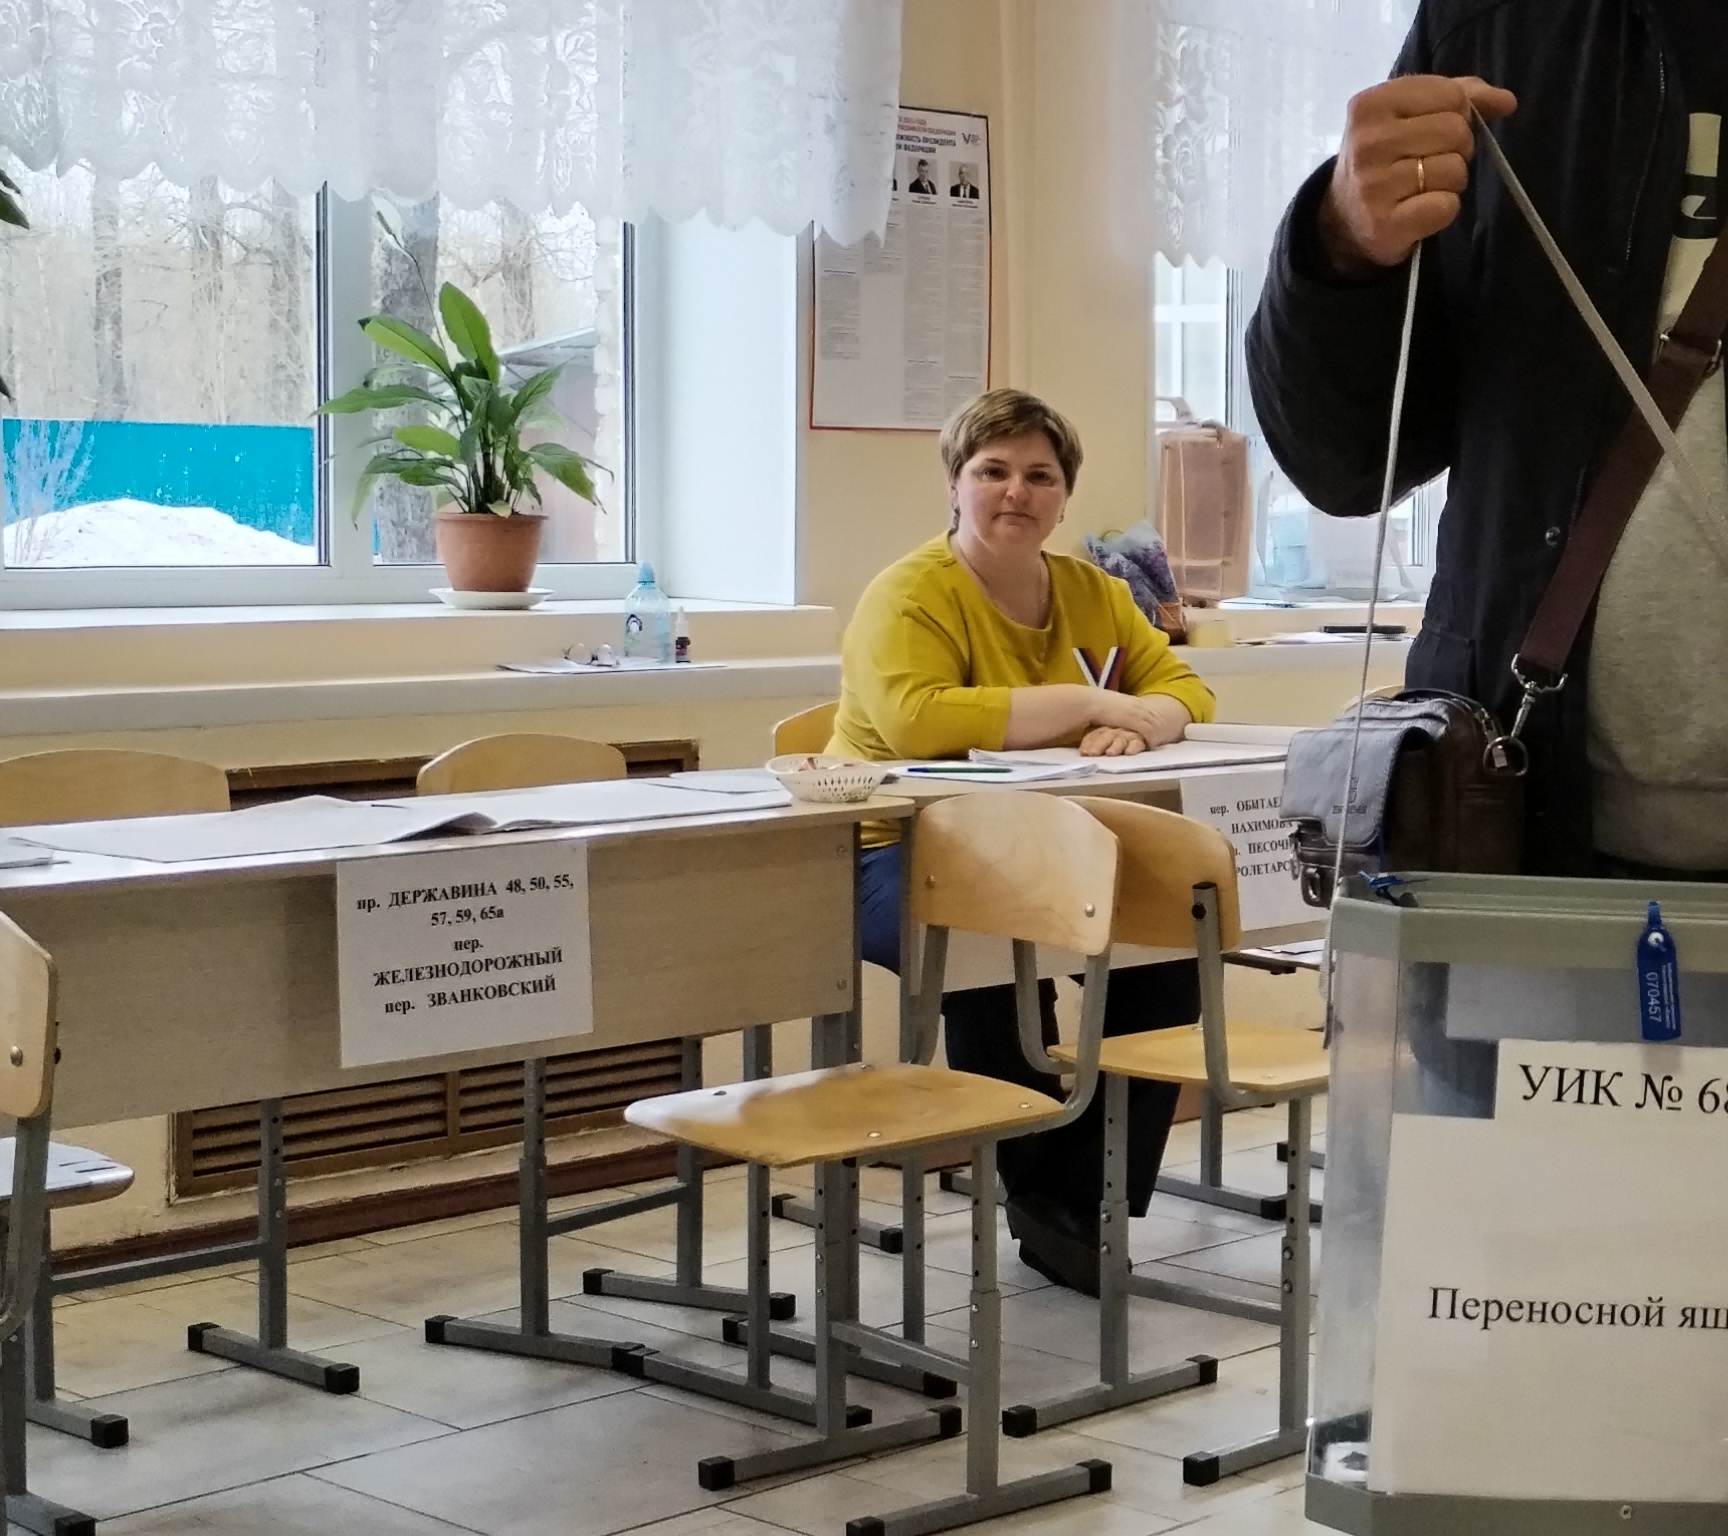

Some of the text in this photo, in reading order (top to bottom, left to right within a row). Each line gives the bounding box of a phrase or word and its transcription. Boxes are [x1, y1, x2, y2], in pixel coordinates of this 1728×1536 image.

[357, 896, 380, 913] пр.
[388, 881, 497, 909] ДЕРЖАВИНА
[505, 878, 526, 895] 48,
[553, 874, 574, 890] 55,
[431, 906, 504, 927] 57, 59, 65а
[454, 937, 484, 953] пер.
[373, 946, 563, 987] ЖЕЛЕЗНОДОРОЖНЫЙ
[384, 973, 557, 1015] пер. ЗВАНКОВСКИЙ
[1646, 971, 1662, 1023] 070457
[1518, 1064, 1623, 1107] УИК
[1635, 1073, 1683, 1112] №
[1427, 1287, 1666, 1330] Переносной
